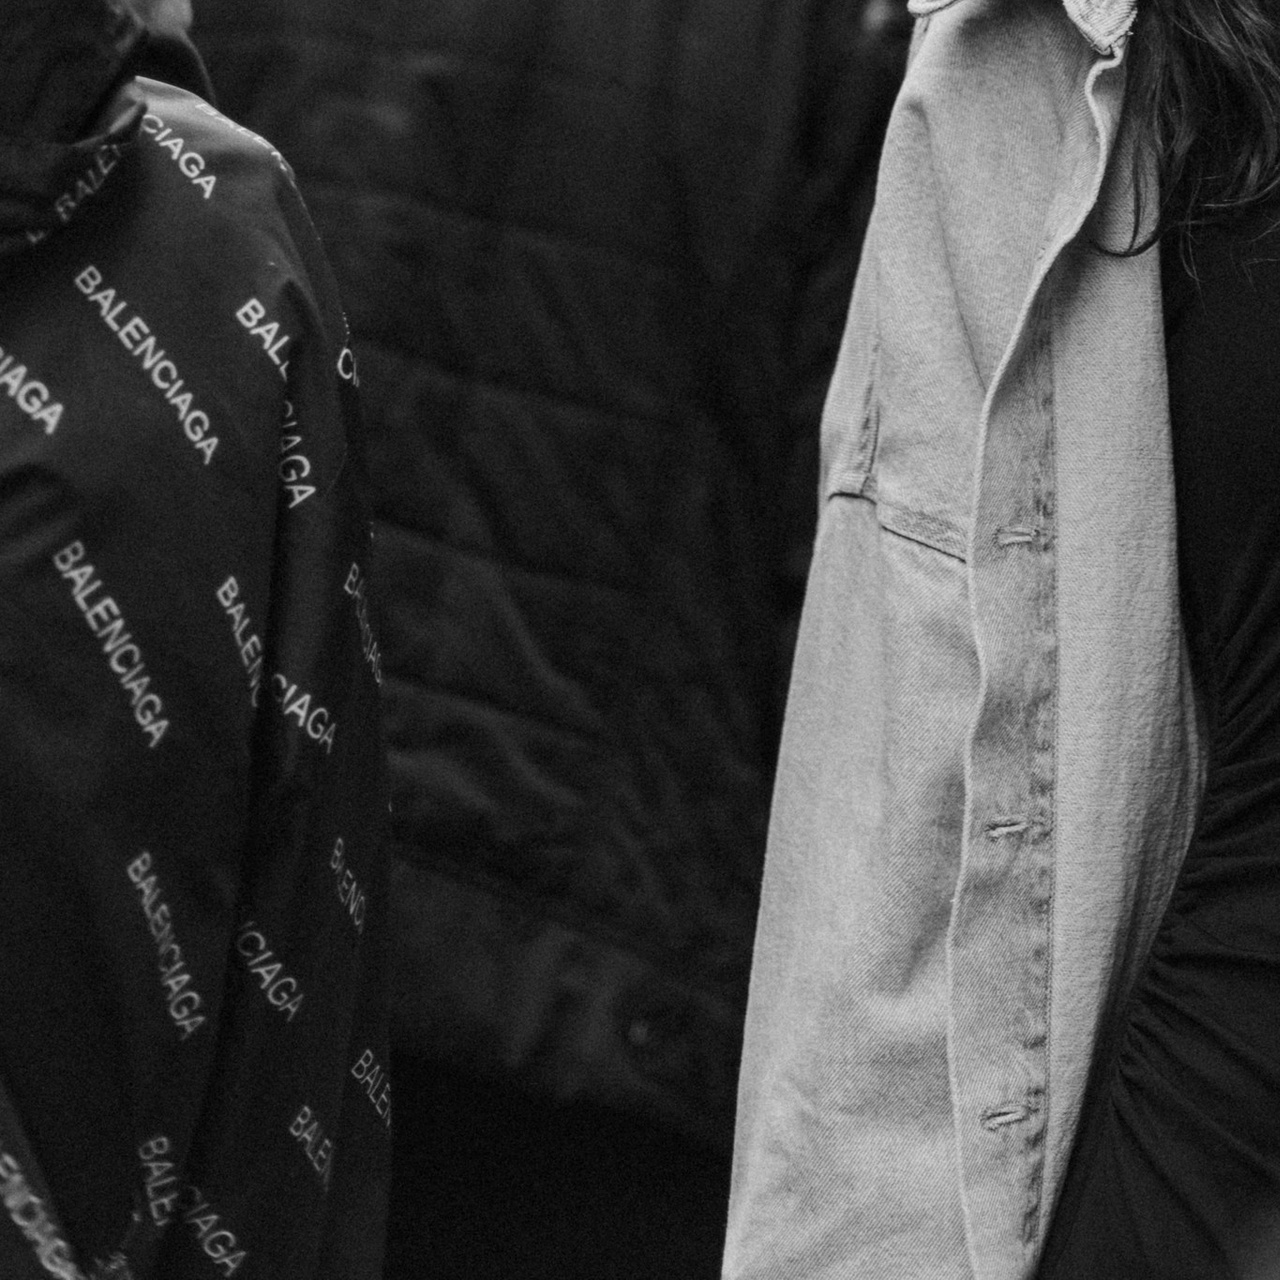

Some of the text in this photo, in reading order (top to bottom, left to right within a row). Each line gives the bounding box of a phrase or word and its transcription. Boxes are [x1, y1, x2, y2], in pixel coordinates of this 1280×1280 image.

[74, 265, 219, 465] BALENCIAGA
[53, 540, 169, 748] BALENCIAGA
[127, 852, 205, 1040] BALENCIAGA
[236, 920, 304, 1022] CIAGA
